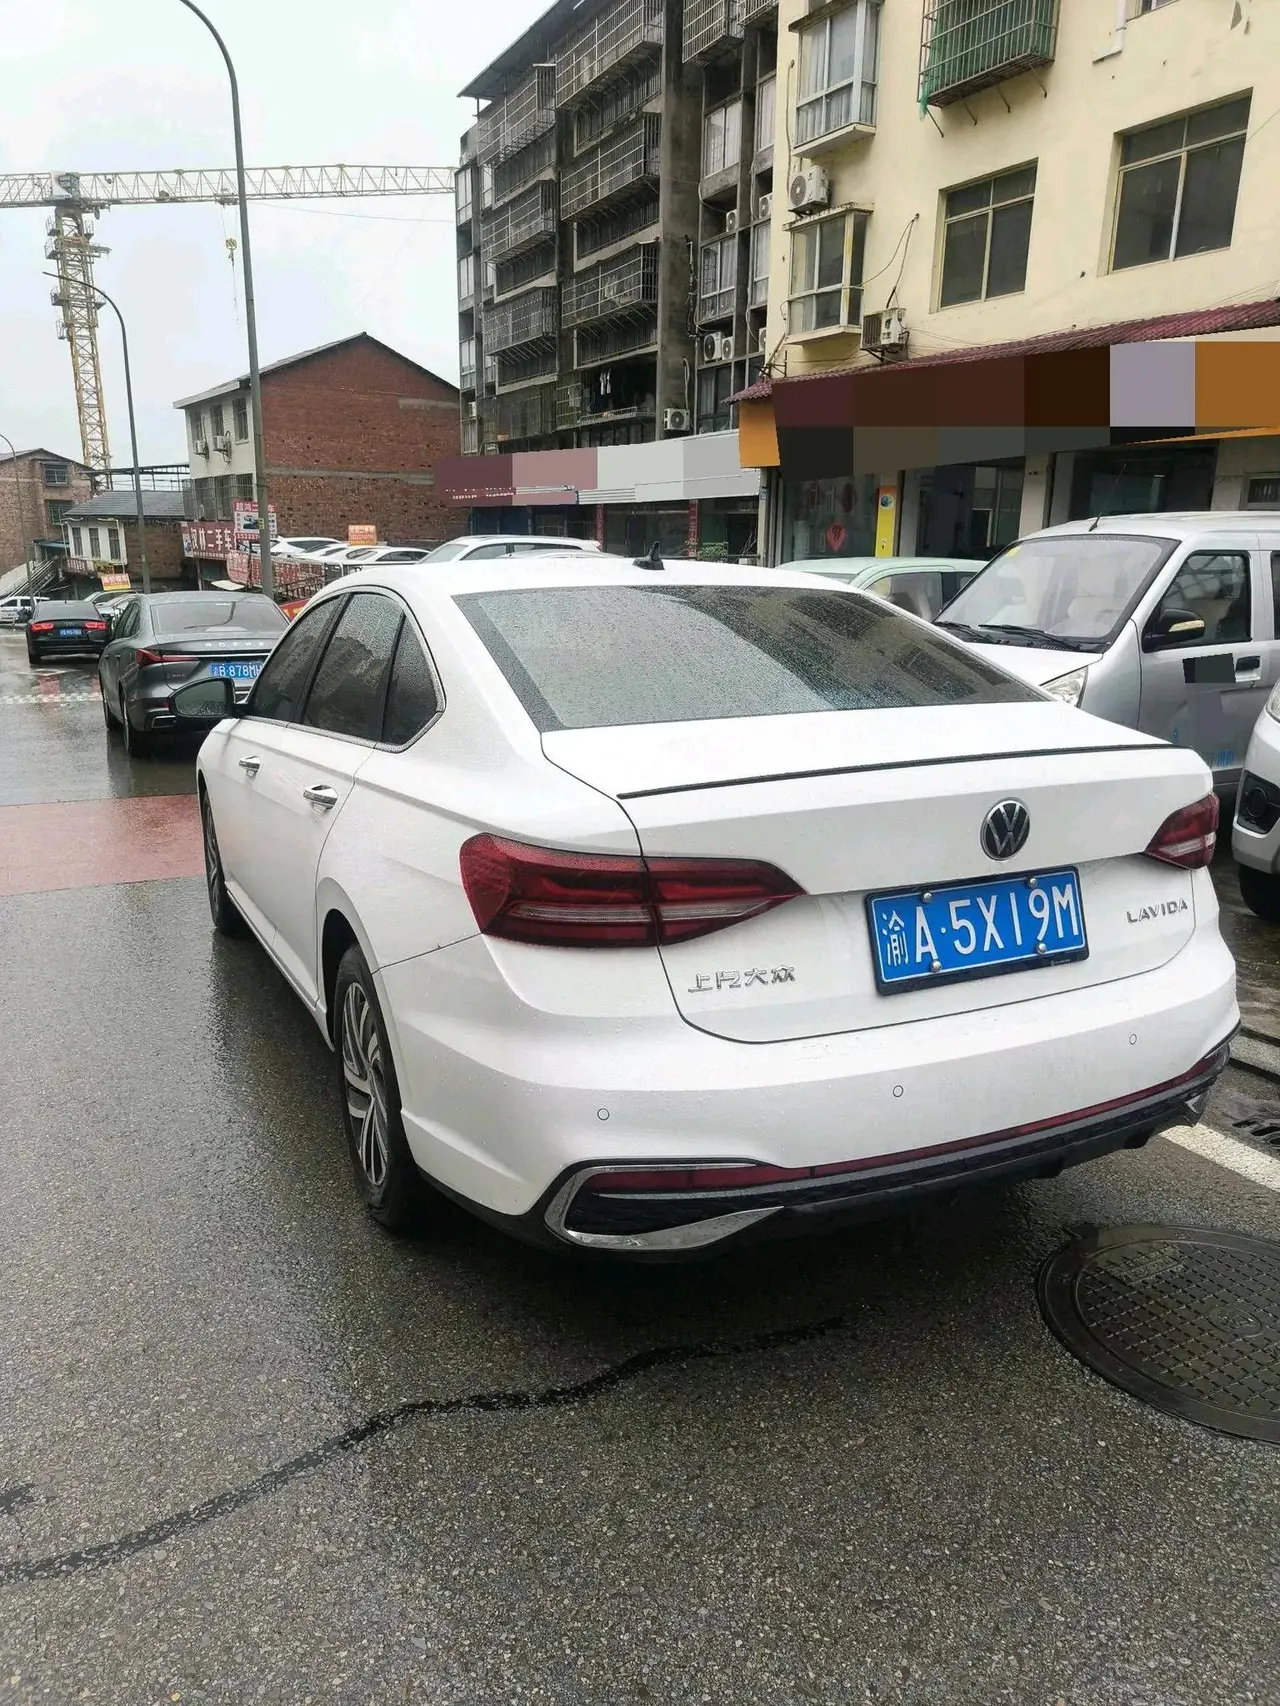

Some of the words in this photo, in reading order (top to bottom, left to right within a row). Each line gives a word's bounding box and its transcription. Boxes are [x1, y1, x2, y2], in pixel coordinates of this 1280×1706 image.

[1126, 899, 1188, 923] LAVIDA
[687, 964, 797, 994] 上汽大众
